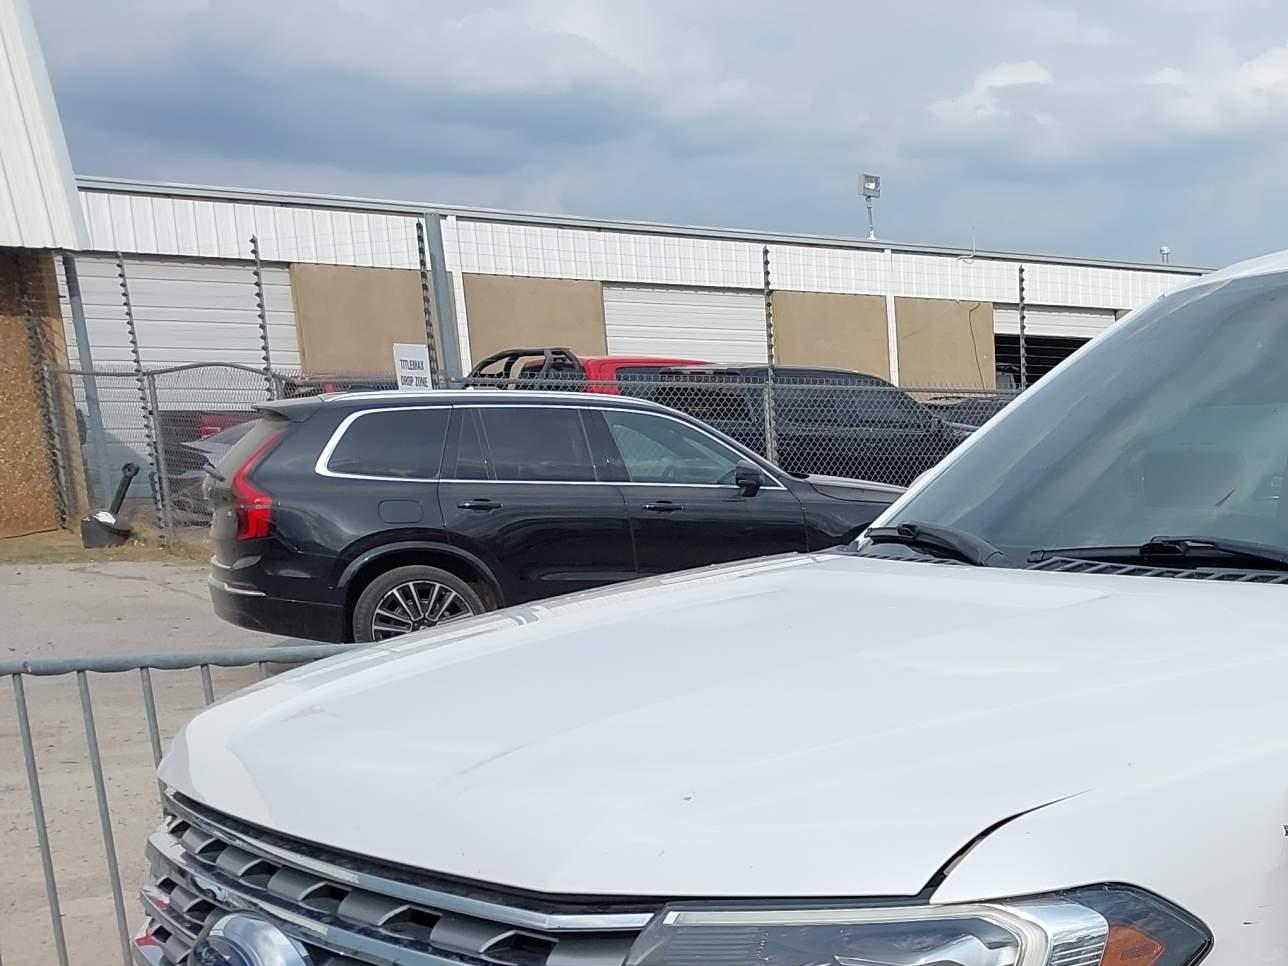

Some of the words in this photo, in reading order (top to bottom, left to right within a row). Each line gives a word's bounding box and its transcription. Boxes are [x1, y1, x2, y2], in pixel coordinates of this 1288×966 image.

[399, 359, 424, 370] TITLEMAX
[400, 375, 414, 386] DROP
[415, 376, 429, 388] ZONE
